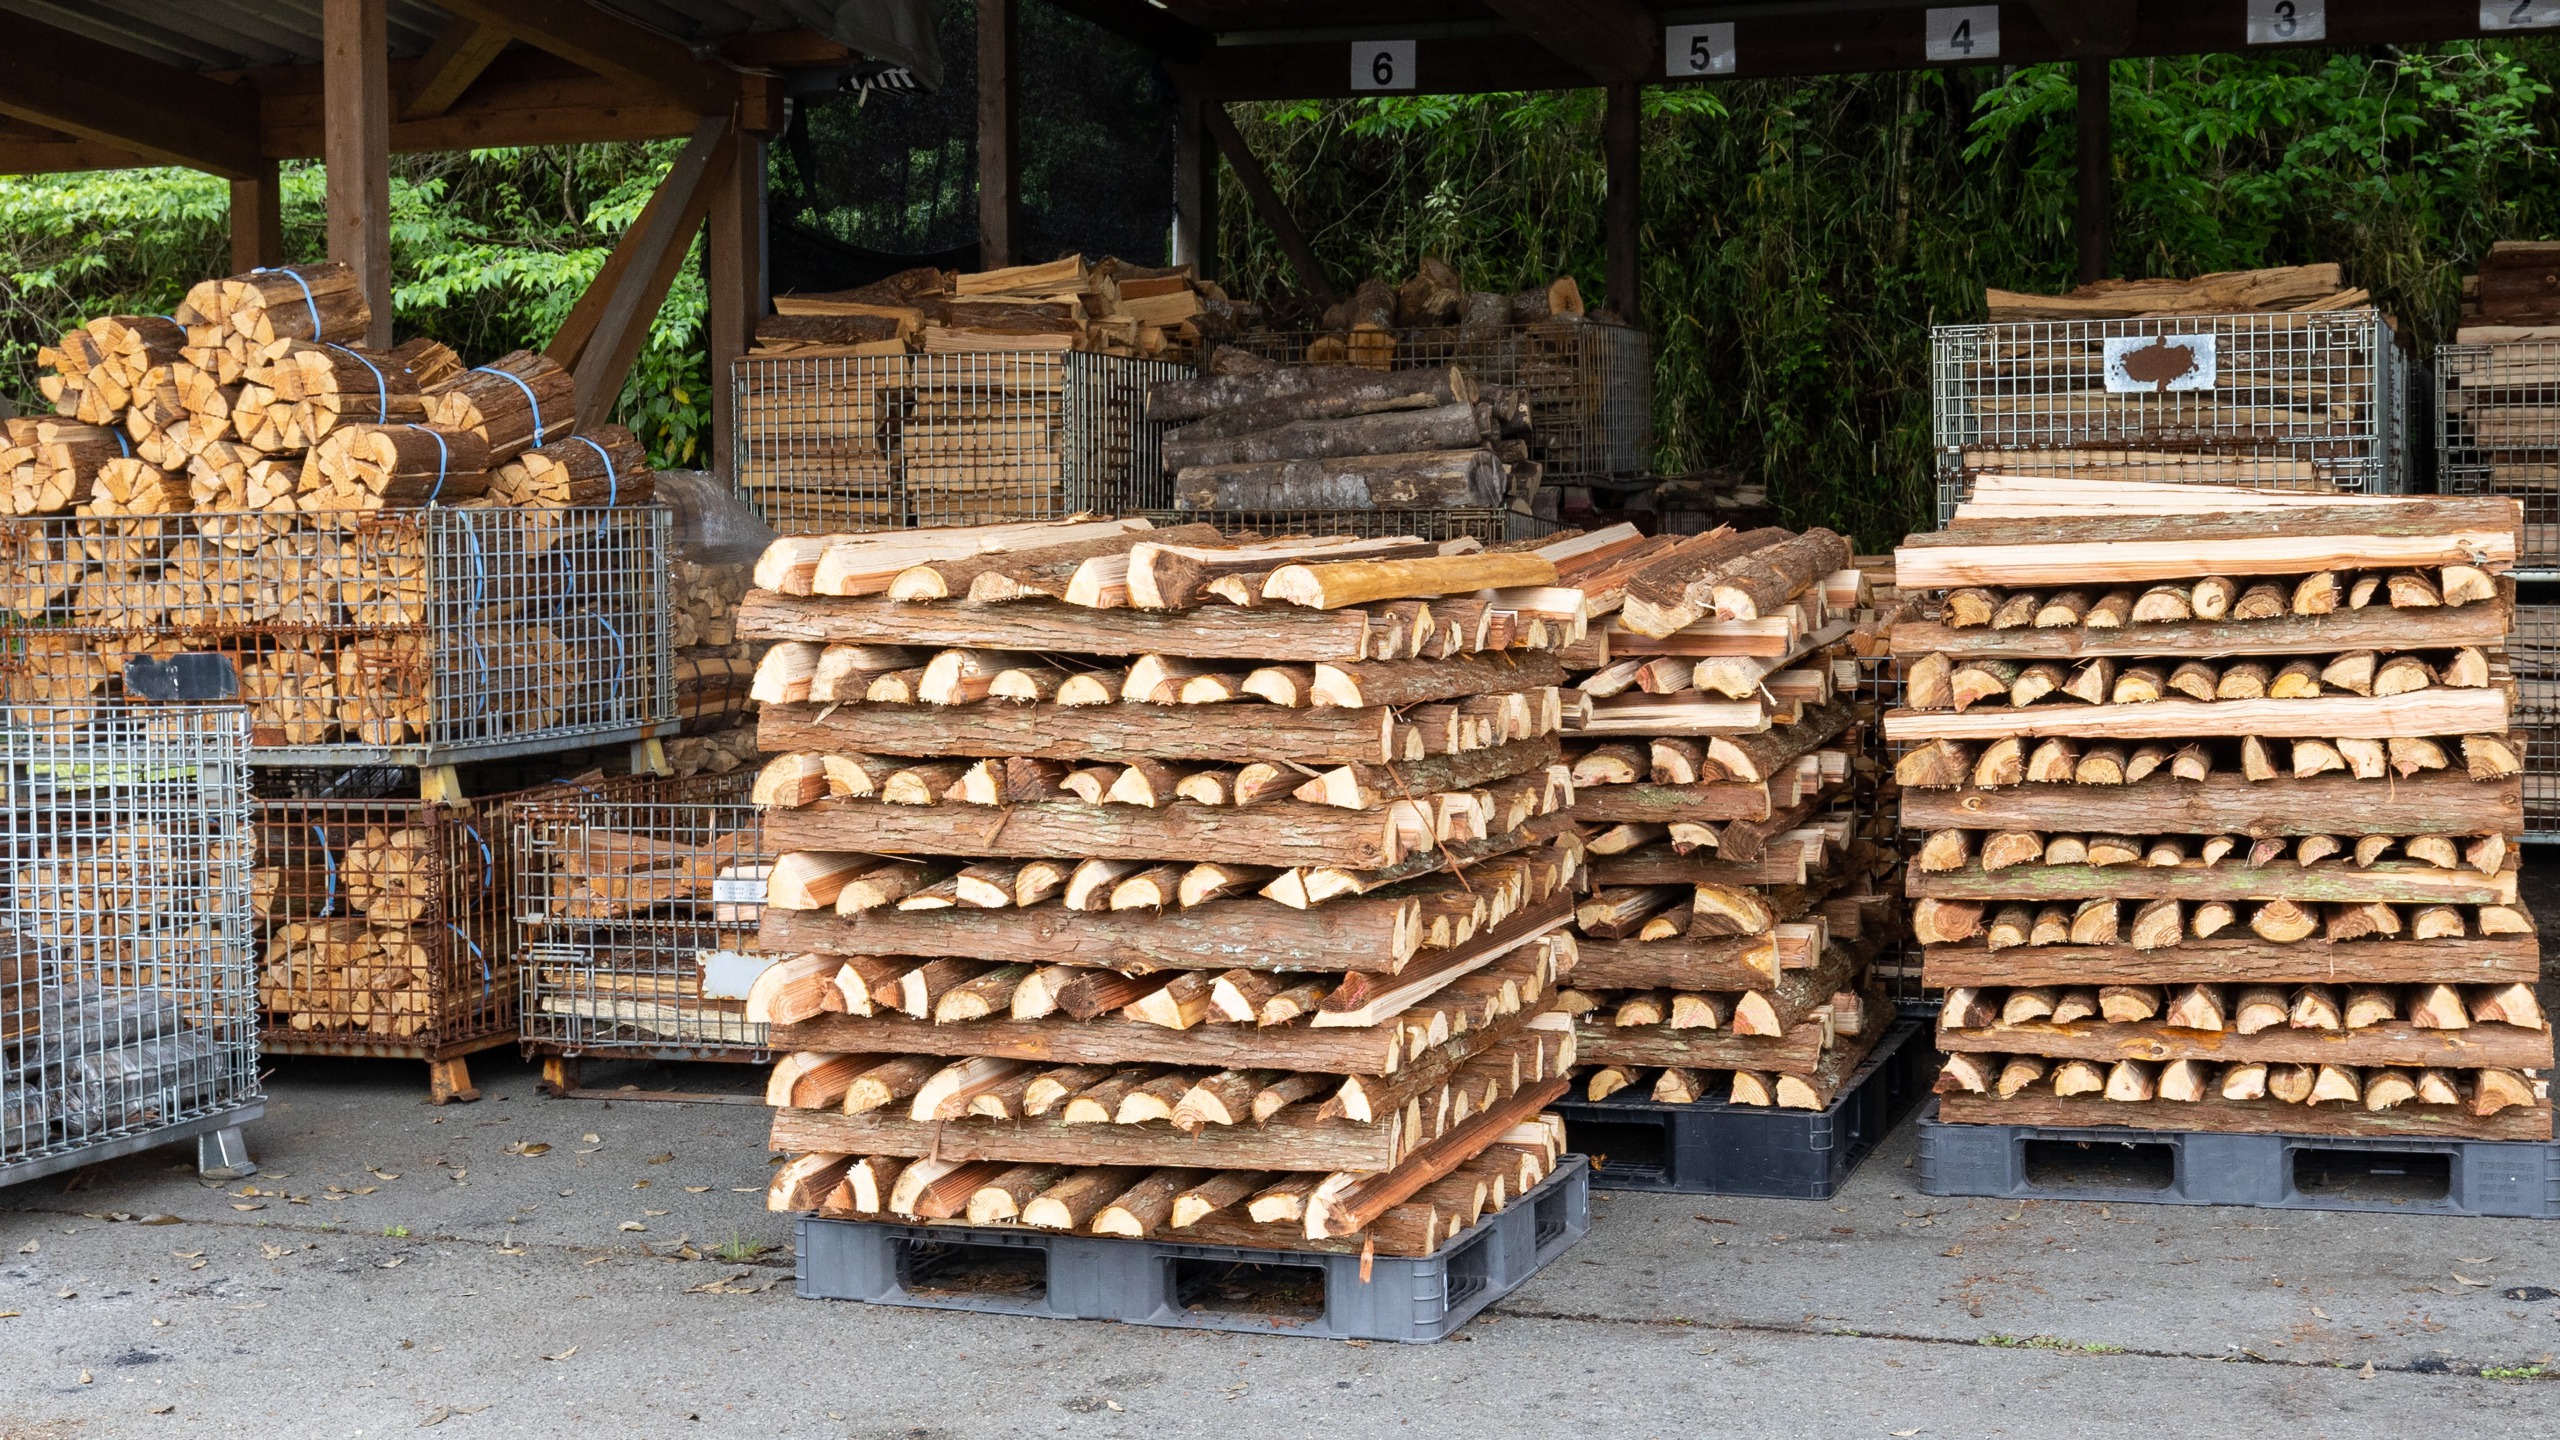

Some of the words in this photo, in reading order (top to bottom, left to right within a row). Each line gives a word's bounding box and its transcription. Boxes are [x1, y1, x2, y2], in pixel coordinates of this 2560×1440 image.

[2274, 1, 2297, 37] 3
[2509, 0, 2532, 24] 2
[1690, 35, 1710, 71] 5
[1950, 19, 1974, 54] 4
[1373, 52, 1393, 85] 6
